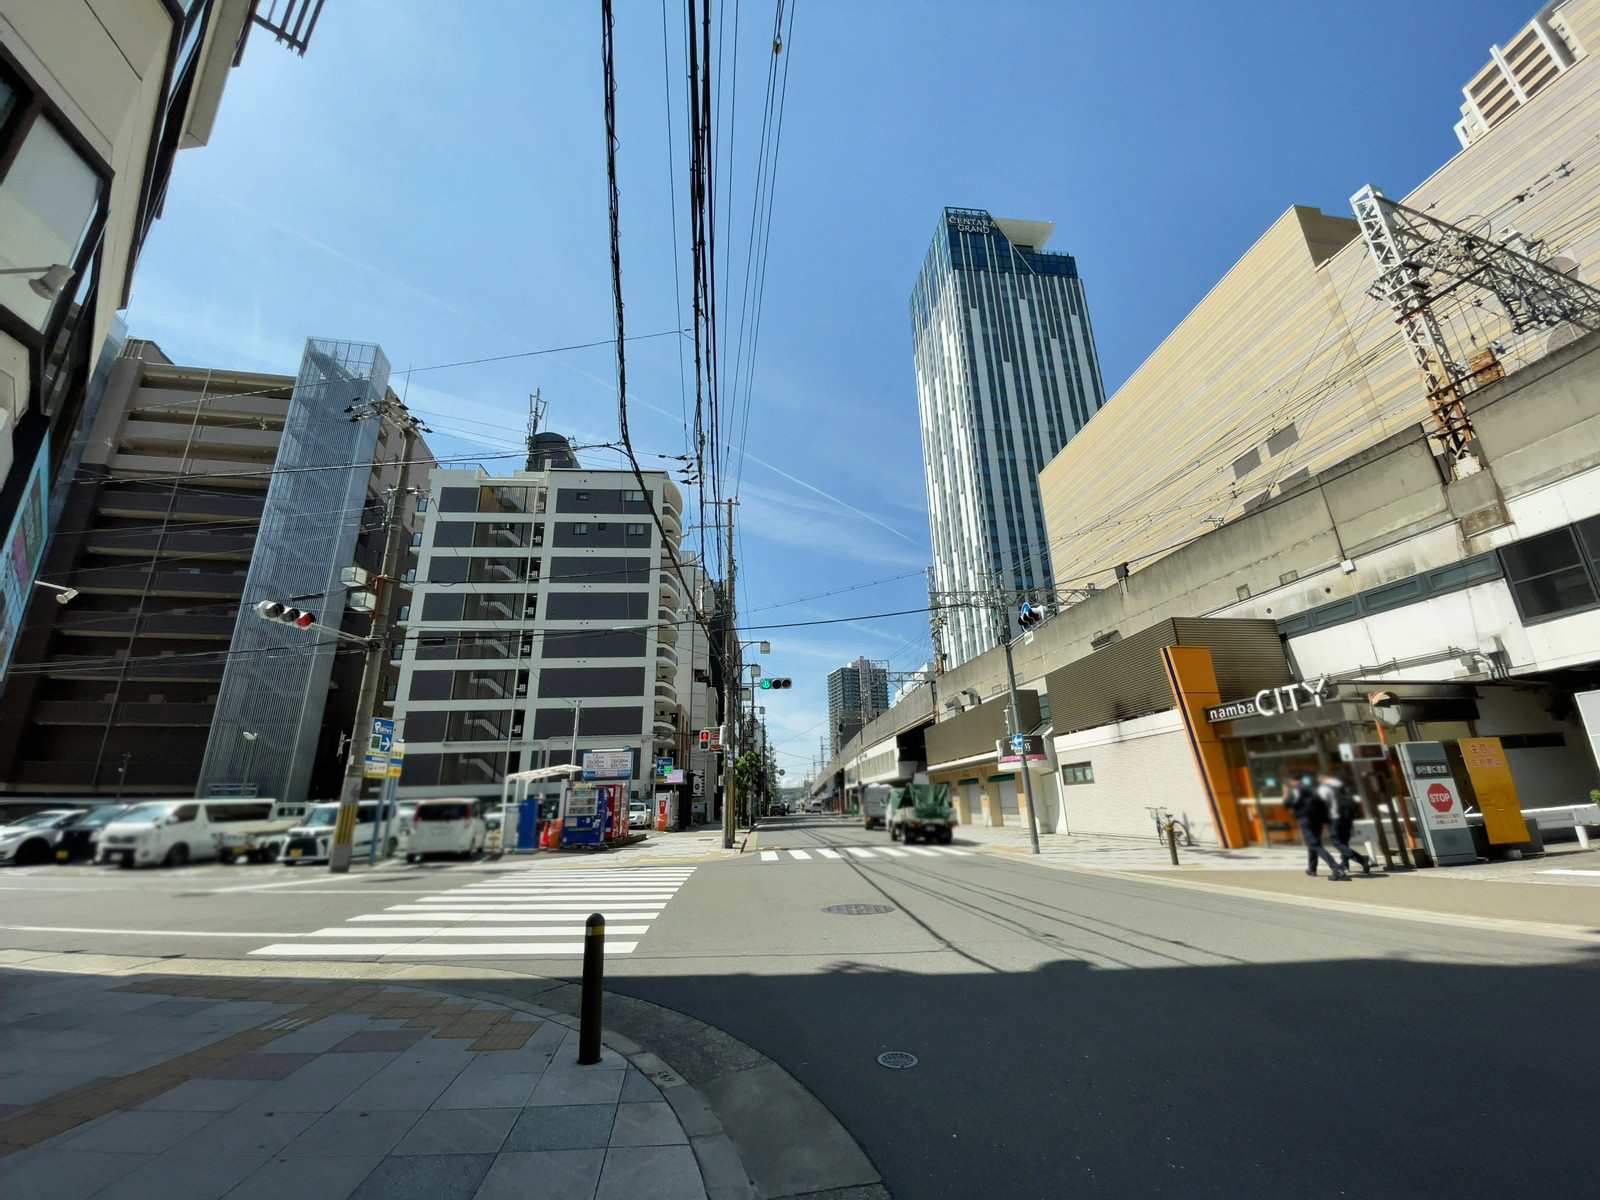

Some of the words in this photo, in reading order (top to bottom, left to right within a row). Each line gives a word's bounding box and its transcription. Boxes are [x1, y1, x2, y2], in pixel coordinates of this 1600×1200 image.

[949, 215, 996, 227] CENTARA
[958, 224, 990, 234] GRAND
[1209, 702, 1254, 719] namba
[1255, 677, 1325, 716] CITY
[1416, 764, 1447, 774] 歩行者に注意
[1429, 793, 1450, 802] STOP
